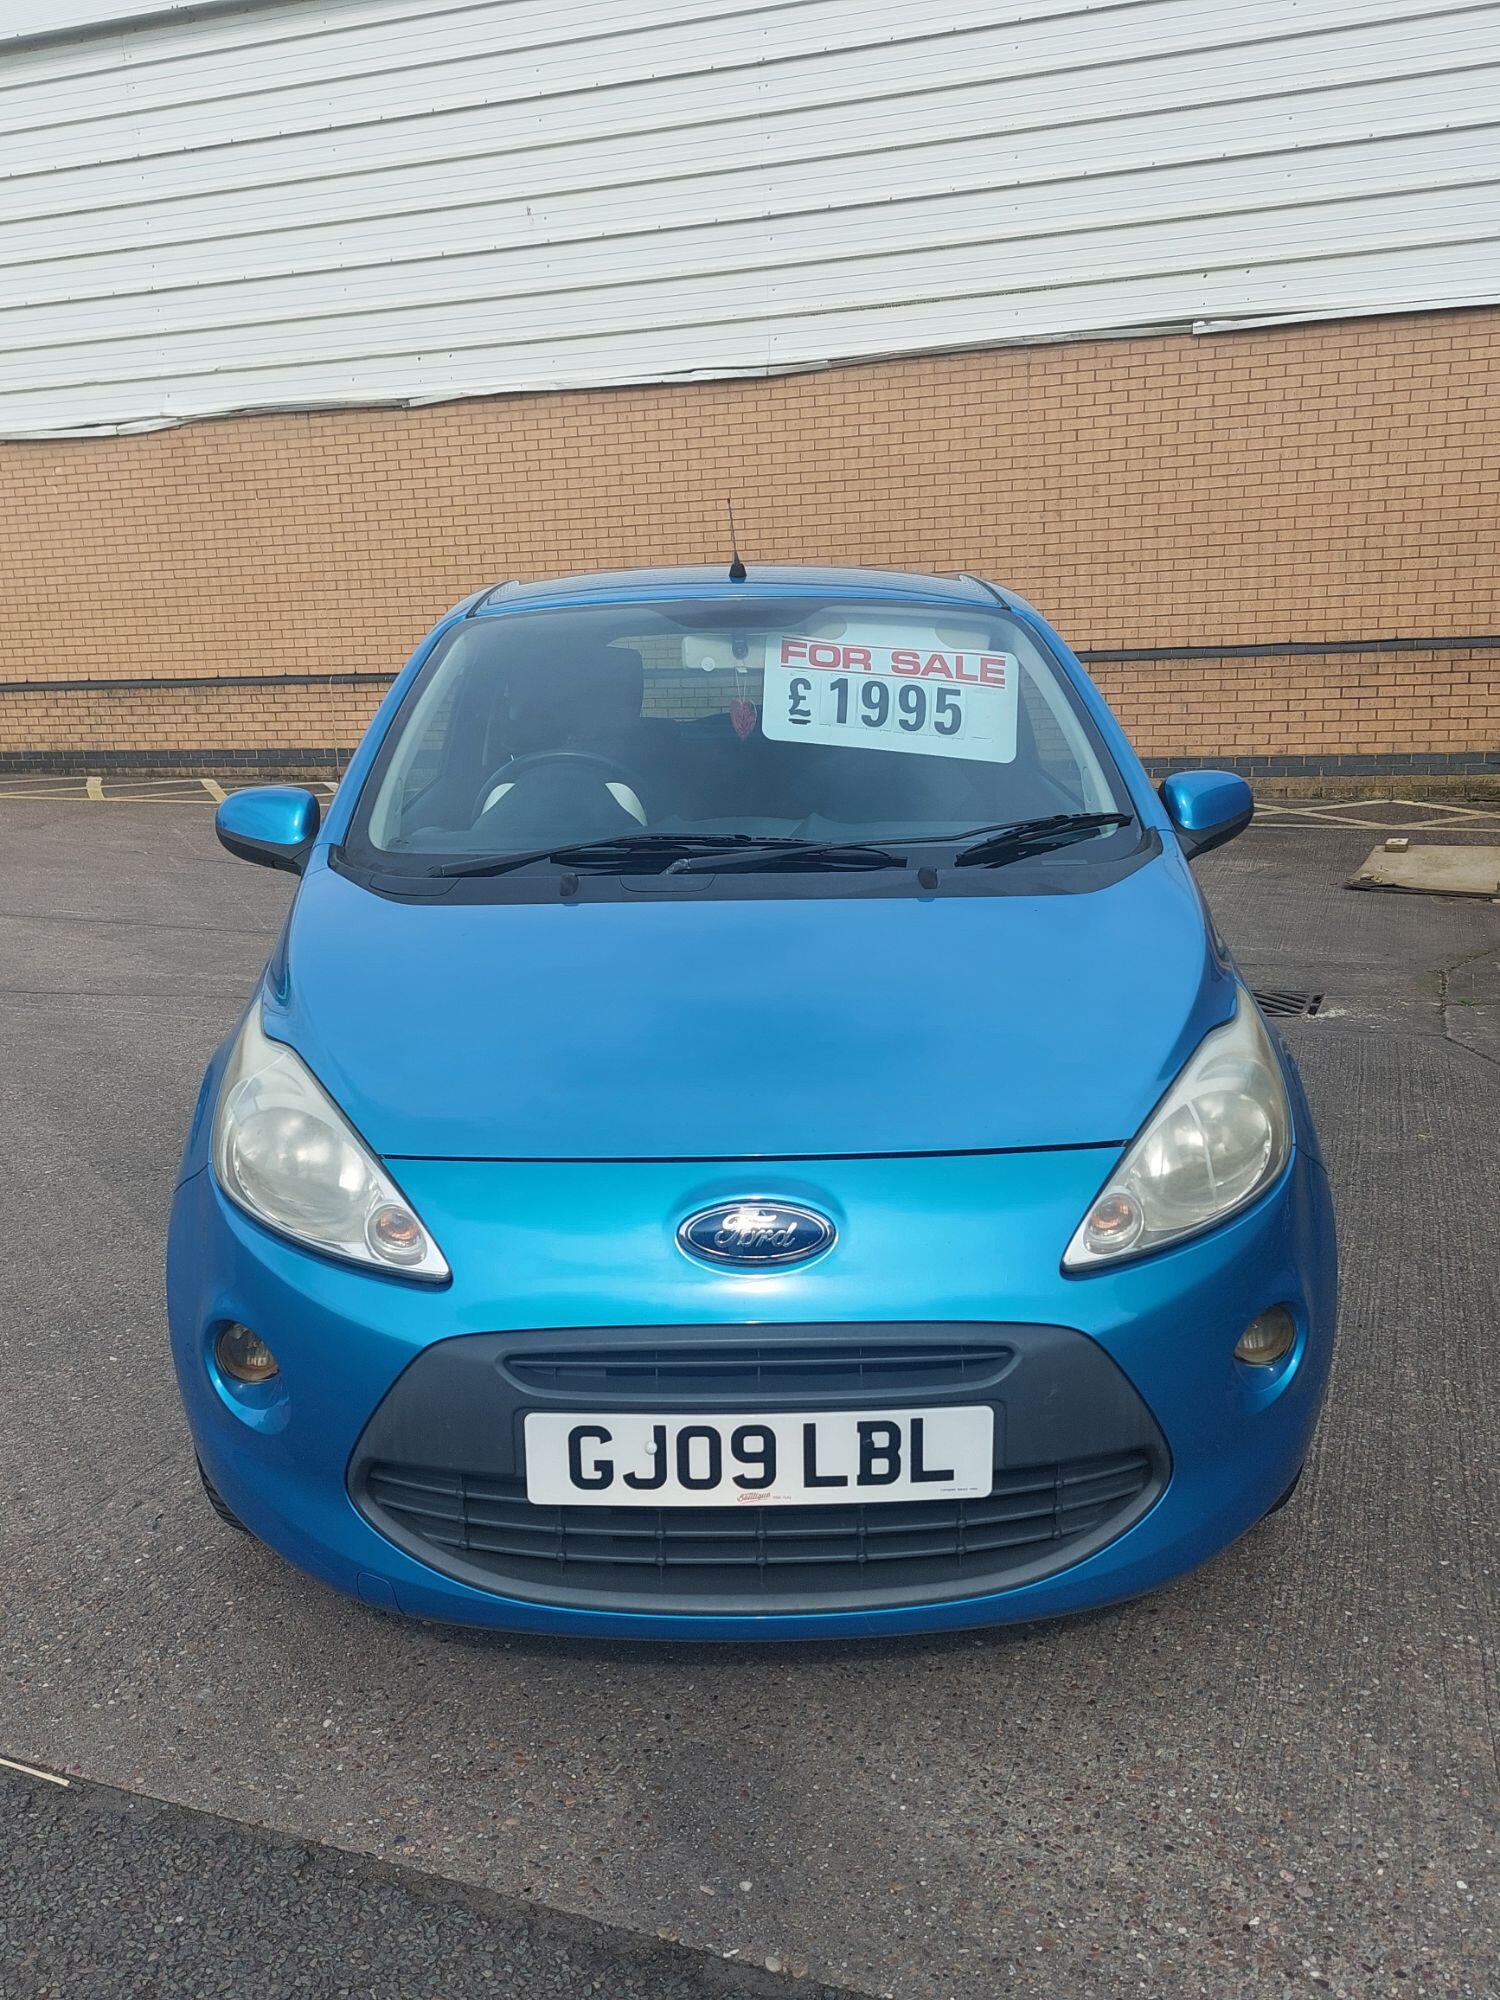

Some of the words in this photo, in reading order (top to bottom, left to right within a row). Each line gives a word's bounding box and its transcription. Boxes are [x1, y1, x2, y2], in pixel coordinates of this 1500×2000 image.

[781, 639, 872, 671] FOR
[891, 651, 1006, 686] SALE
[714, 1212, 798, 1248] Ford
[567, 1424, 777, 1491] GJ09
[803, 1418, 954, 1489] LBL
